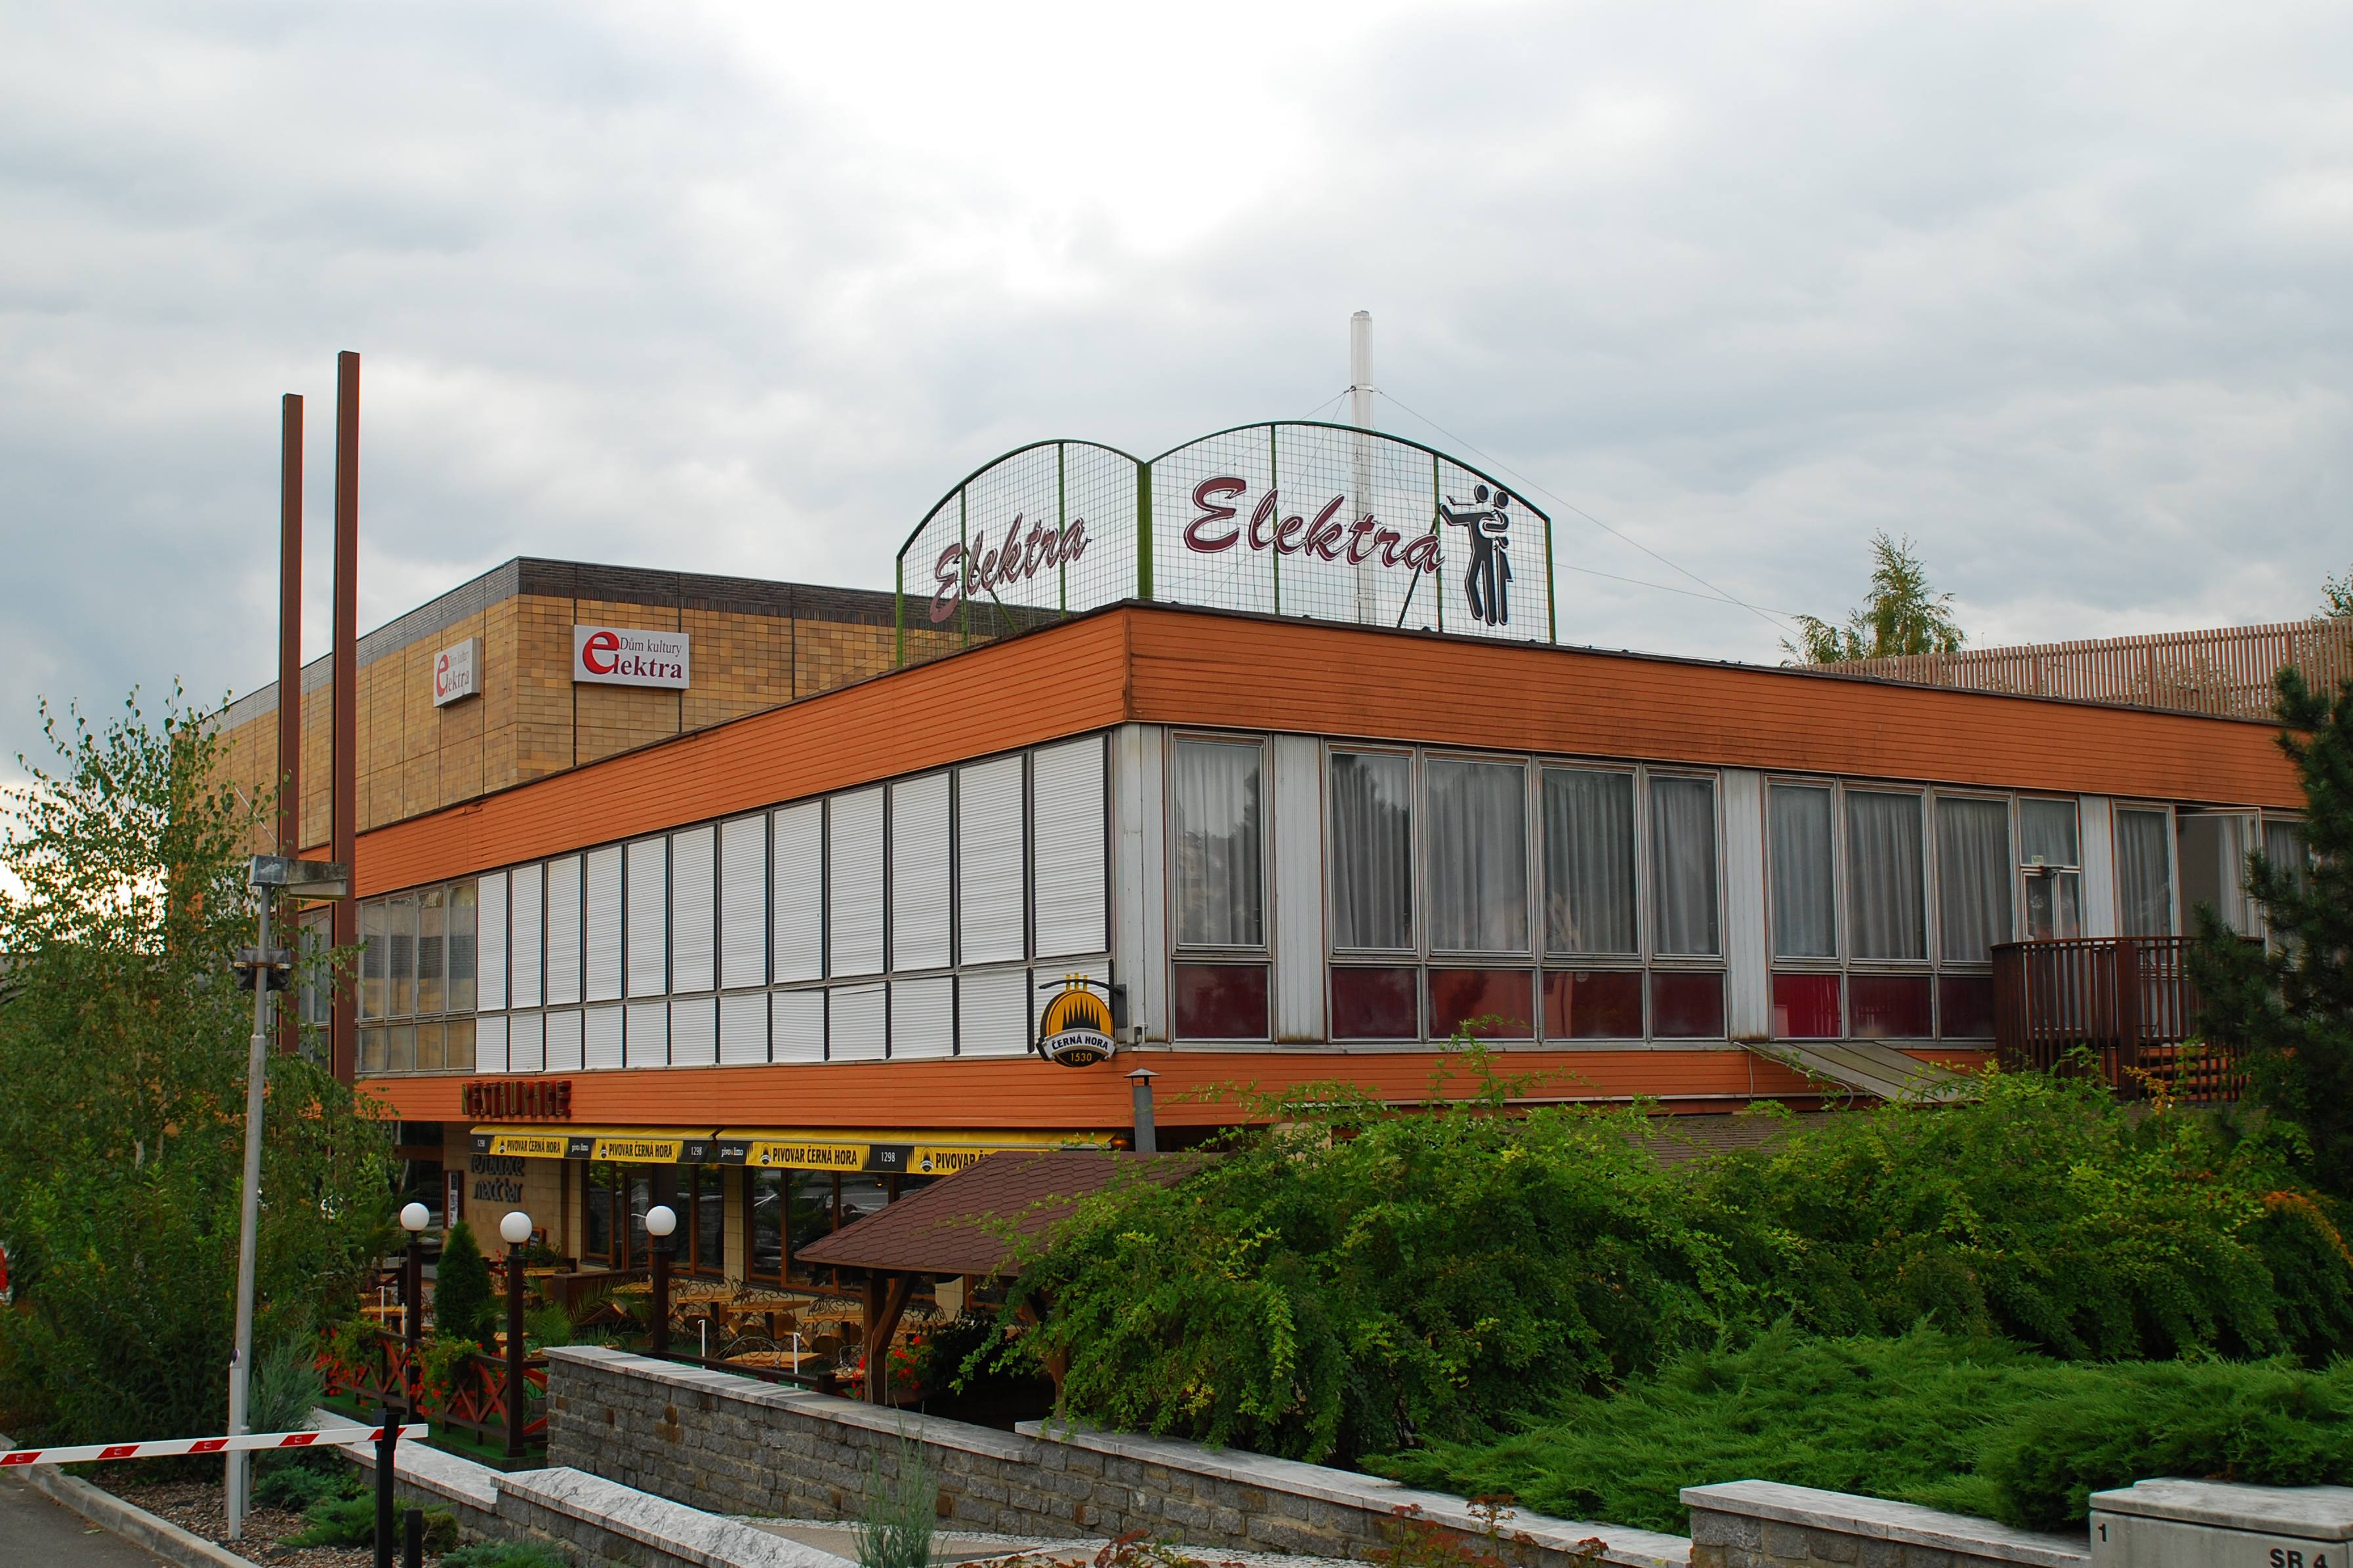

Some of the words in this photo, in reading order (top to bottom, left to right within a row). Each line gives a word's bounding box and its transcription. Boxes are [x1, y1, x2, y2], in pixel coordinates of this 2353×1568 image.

[1183, 476, 1445, 574] Elektra
[930, 512, 1087, 623] Elektra
[620, 637, 644, 651] Dům
[647, 639, 682, 657] kultury
[1052, 1034, 1082, 1050] ČERNÁ
[1084, 1036, 1109, 1050] HORA
[1071, 1053, 1092, 1062] 1530
[507, 1140, 527, 1152] PIVOVAR
[546, 1141, 561, 1153] HORA
[609, 1143, 633, 1156] PIVOVAR
[634, 1141, 653, 1157] ČERNÁ
[655, 1144, 672, 1158] HORA
[773, 1148, 805, 1163] PIVOVAR
[807, 1146, 832, 1164] ČERNÁ
[834, 1149, 857, 1165] HORA
[881, 1152, 895, 1162] 1298
[2098, 1523, 2107, 1542] 1
[2270, 1548, 2304, 1568] SR
[2313, 1553, 2328, 1568] 4
